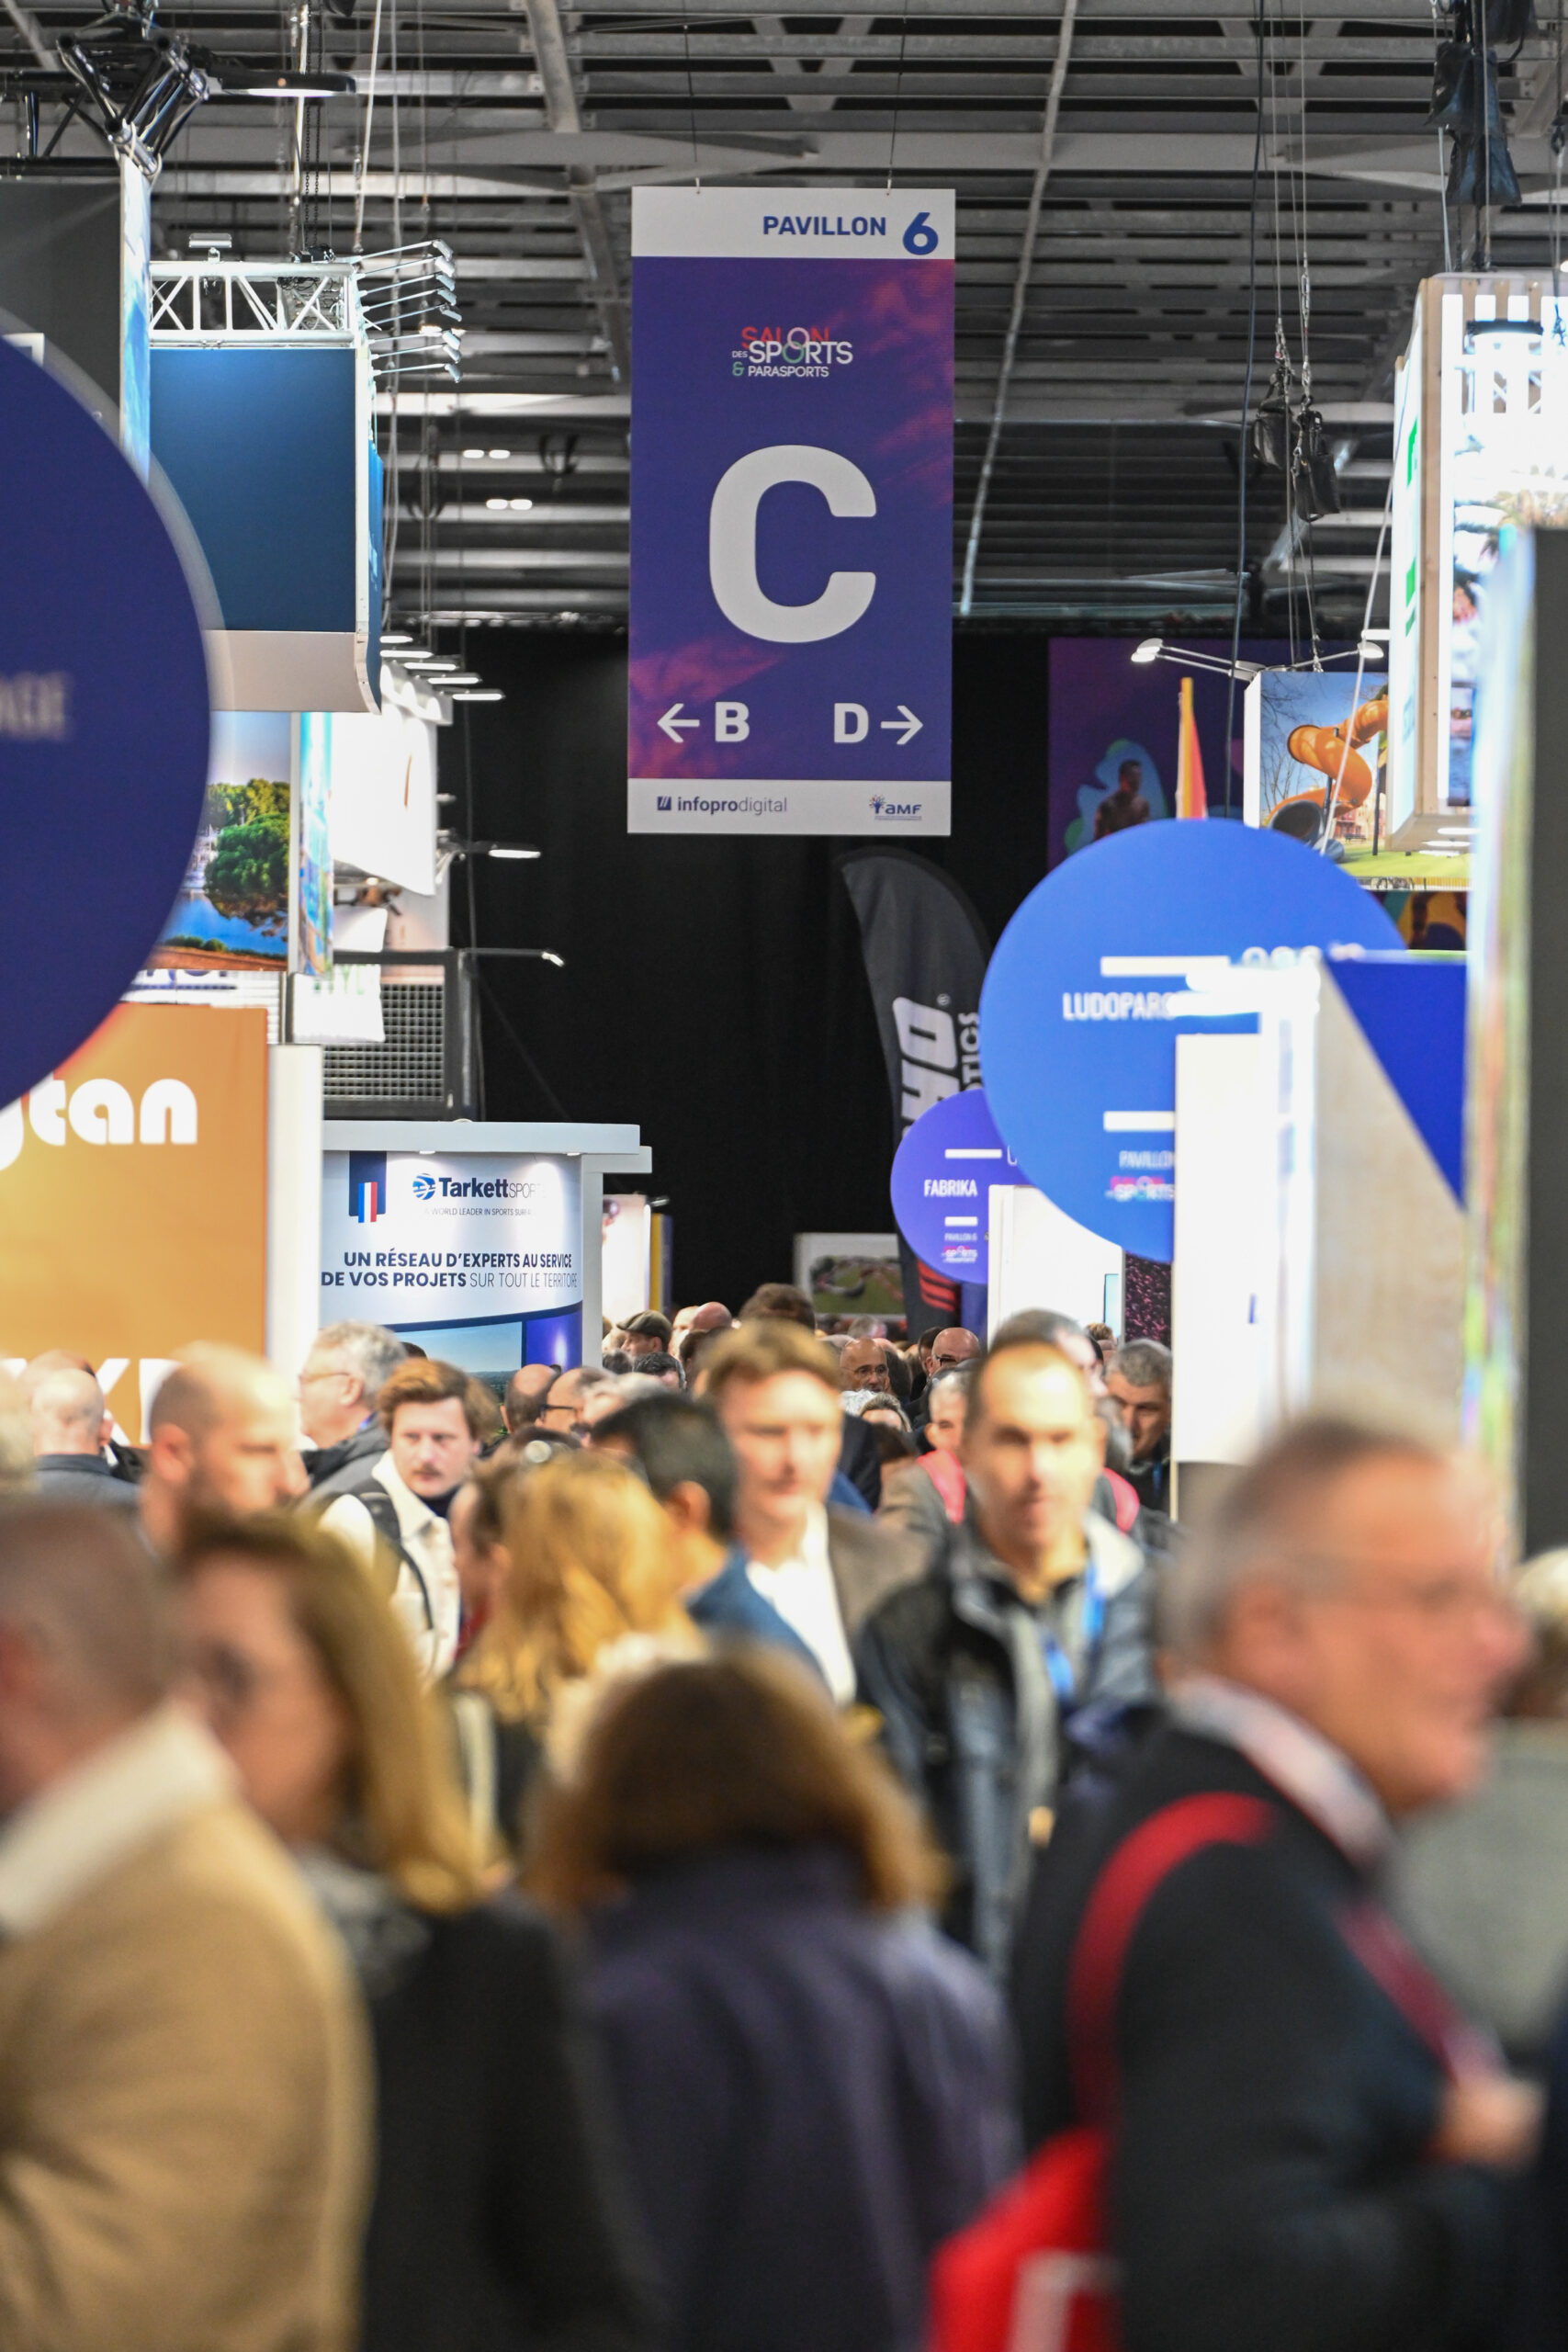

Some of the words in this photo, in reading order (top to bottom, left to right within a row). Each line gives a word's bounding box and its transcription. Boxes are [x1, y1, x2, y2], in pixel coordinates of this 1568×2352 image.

[763, 216, 886, 236] PAVILLON
[902, 211, 939, 255] 6
[731, 350, 749, 358] DES
[749, 340, 853, 364] SPORTS
[732, 360, 745, 377] &
[748, 365, 829, 378] PARASPORTS
[708, 445, 877, 643] C
[715, 701, 750, 742] B
[833, 702, 869, 743] D
[677, 797, 787, 816] infoprodigital
[1119, 1149, 1175, 1169] PAVILLO
[924, 1179, 978, 1197] FABRIKA
[344, 1251, 371, 1267] UN
[376, 1248, 443, 1267] RÉSEAU
[446, 1252, 520, 1268] D’EXPERTS
[522, 1253, 538, 1268] AU
[540, 1253, 572, 1268] SERVICE
[321, 1272, 344, 1286] DE
[348, 1272, 389, 1286] VOS
[392, 1272, 467, 1287] PROJETS
[469, 1272, 495, 1287] SUR
[498, 1272, 528, 1287] TOUT
[530, 1272, 540, 1287] LE
